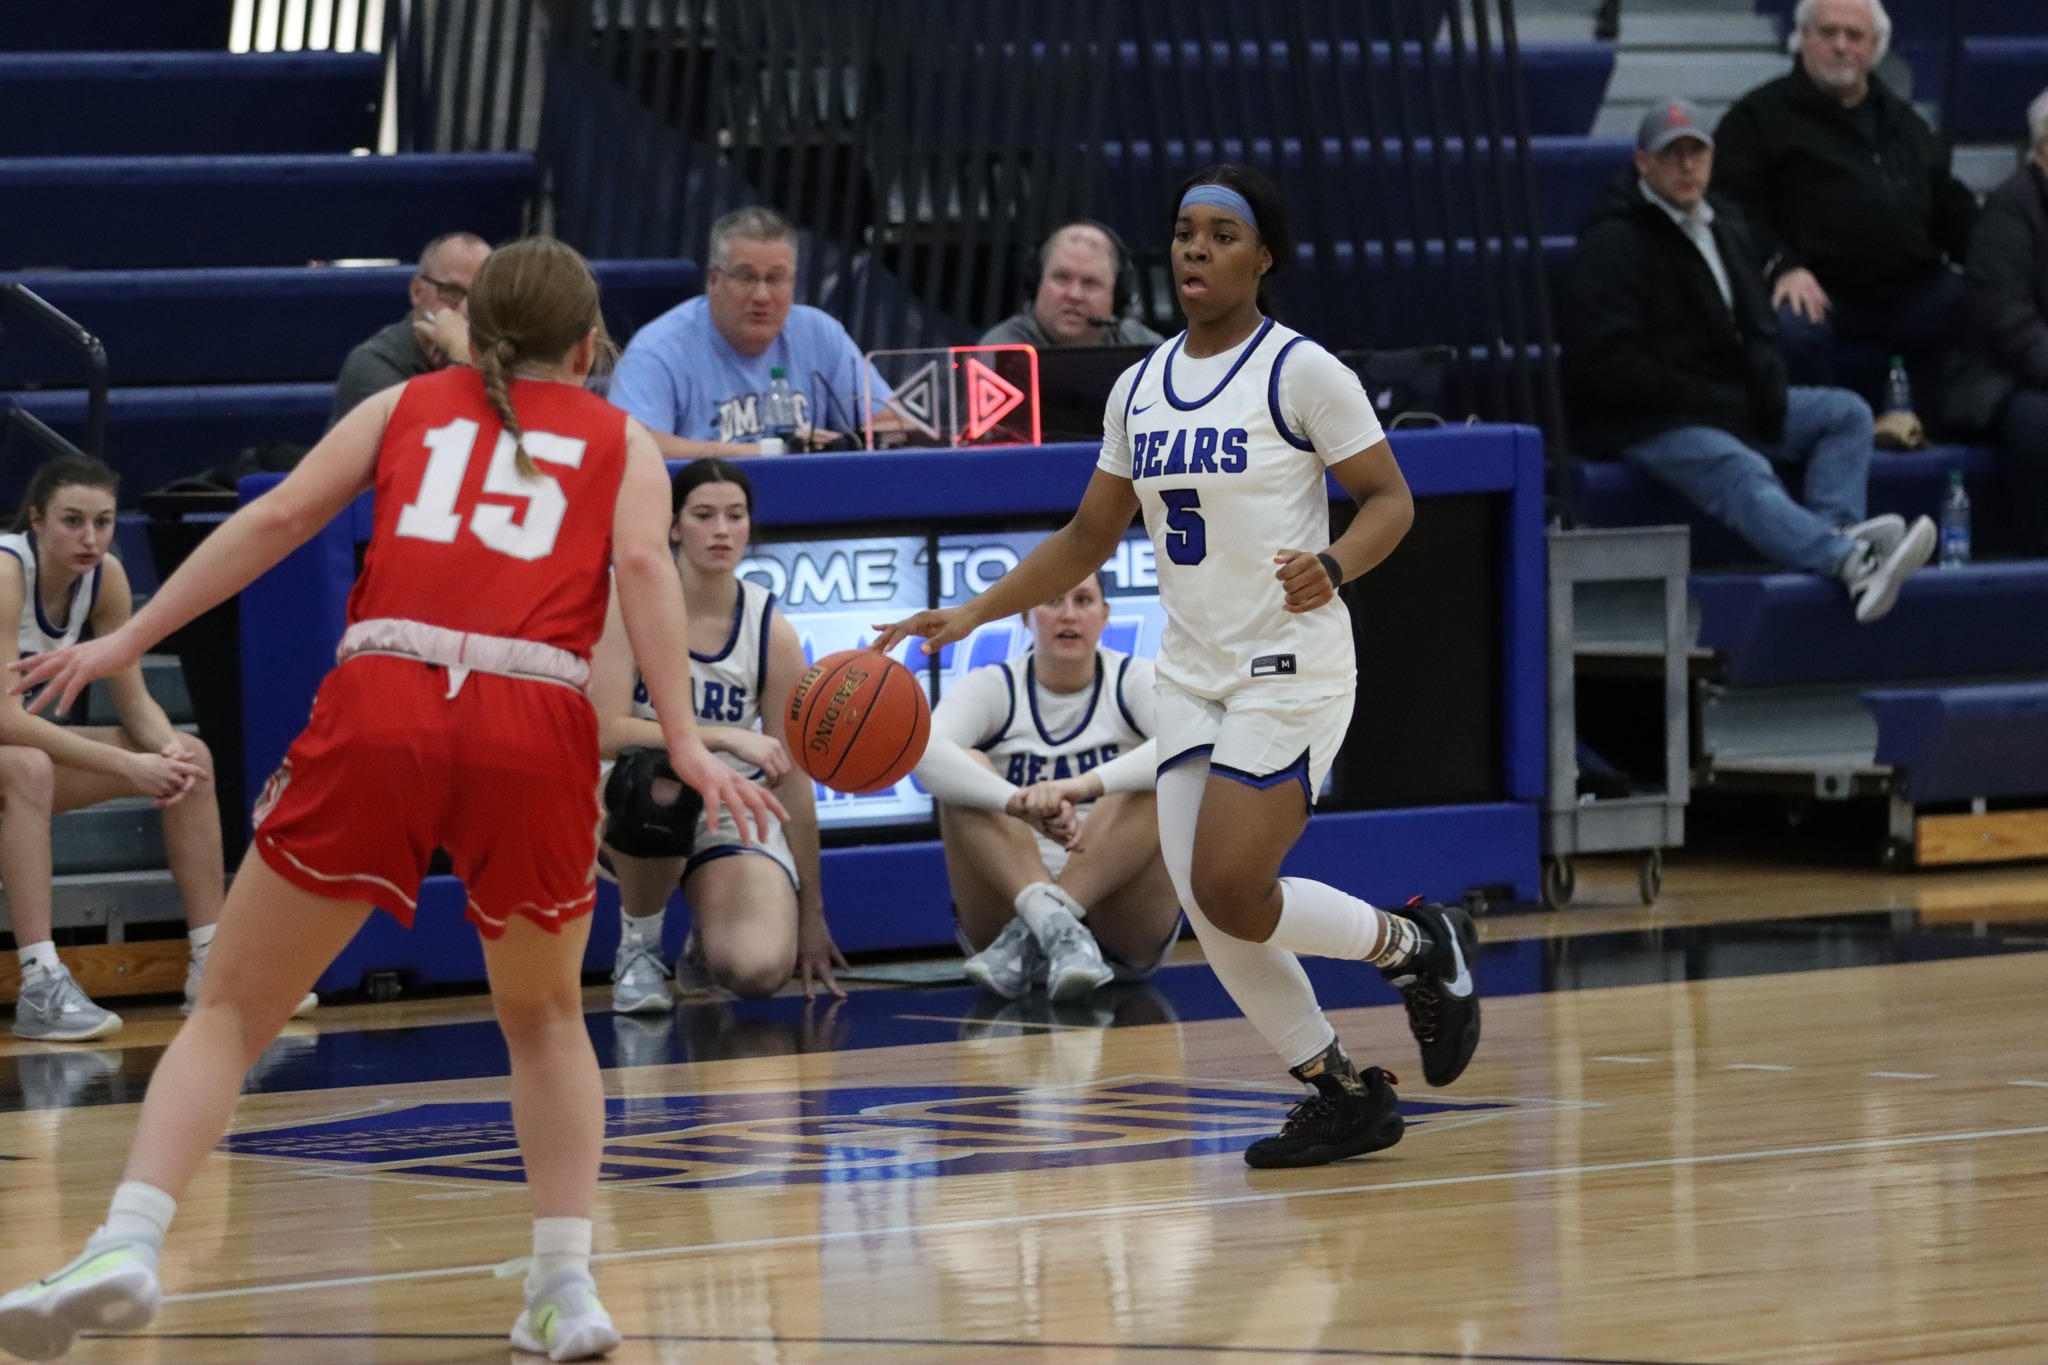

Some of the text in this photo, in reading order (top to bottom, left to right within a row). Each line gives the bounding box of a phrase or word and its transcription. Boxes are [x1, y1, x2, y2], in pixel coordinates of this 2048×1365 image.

[395, 417, 588, 562] 15
[1132, 427, 1248, 481] BEARS
[1159, 488, 1207, 566] 5
[734, 548, 898, 605] OME
[1099, 538, 1161, 590] HE
[810, 667, 870, 755] SPALDING
